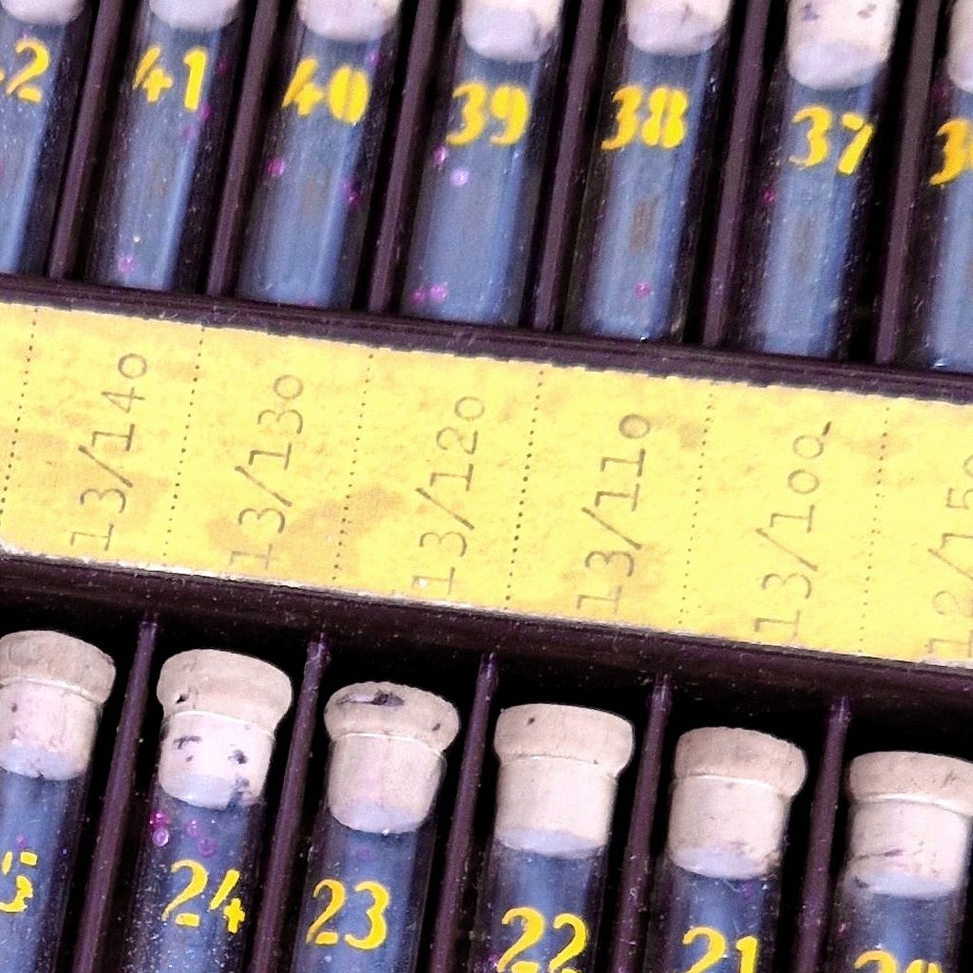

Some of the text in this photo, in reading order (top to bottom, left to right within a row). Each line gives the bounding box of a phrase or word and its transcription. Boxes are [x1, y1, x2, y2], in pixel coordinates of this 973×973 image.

[132, 46, 208, 111] 41
[281, 57, 371, 124] 40
[445, 82, 530, 148] 39
[601, 85, 689, 151] 38
[794, 105, 874, 176] 37
[929, 117, 973, 185] 3
[69, 352, 148, 551] 13/140
[230, 374, 304, 570] 13/130
[411, 395, 486, 596] 13/120
[576, 413, 652, 614] 13/110
[162, 859, 246, 934] 24
[306, 878, 390, 951] 23
